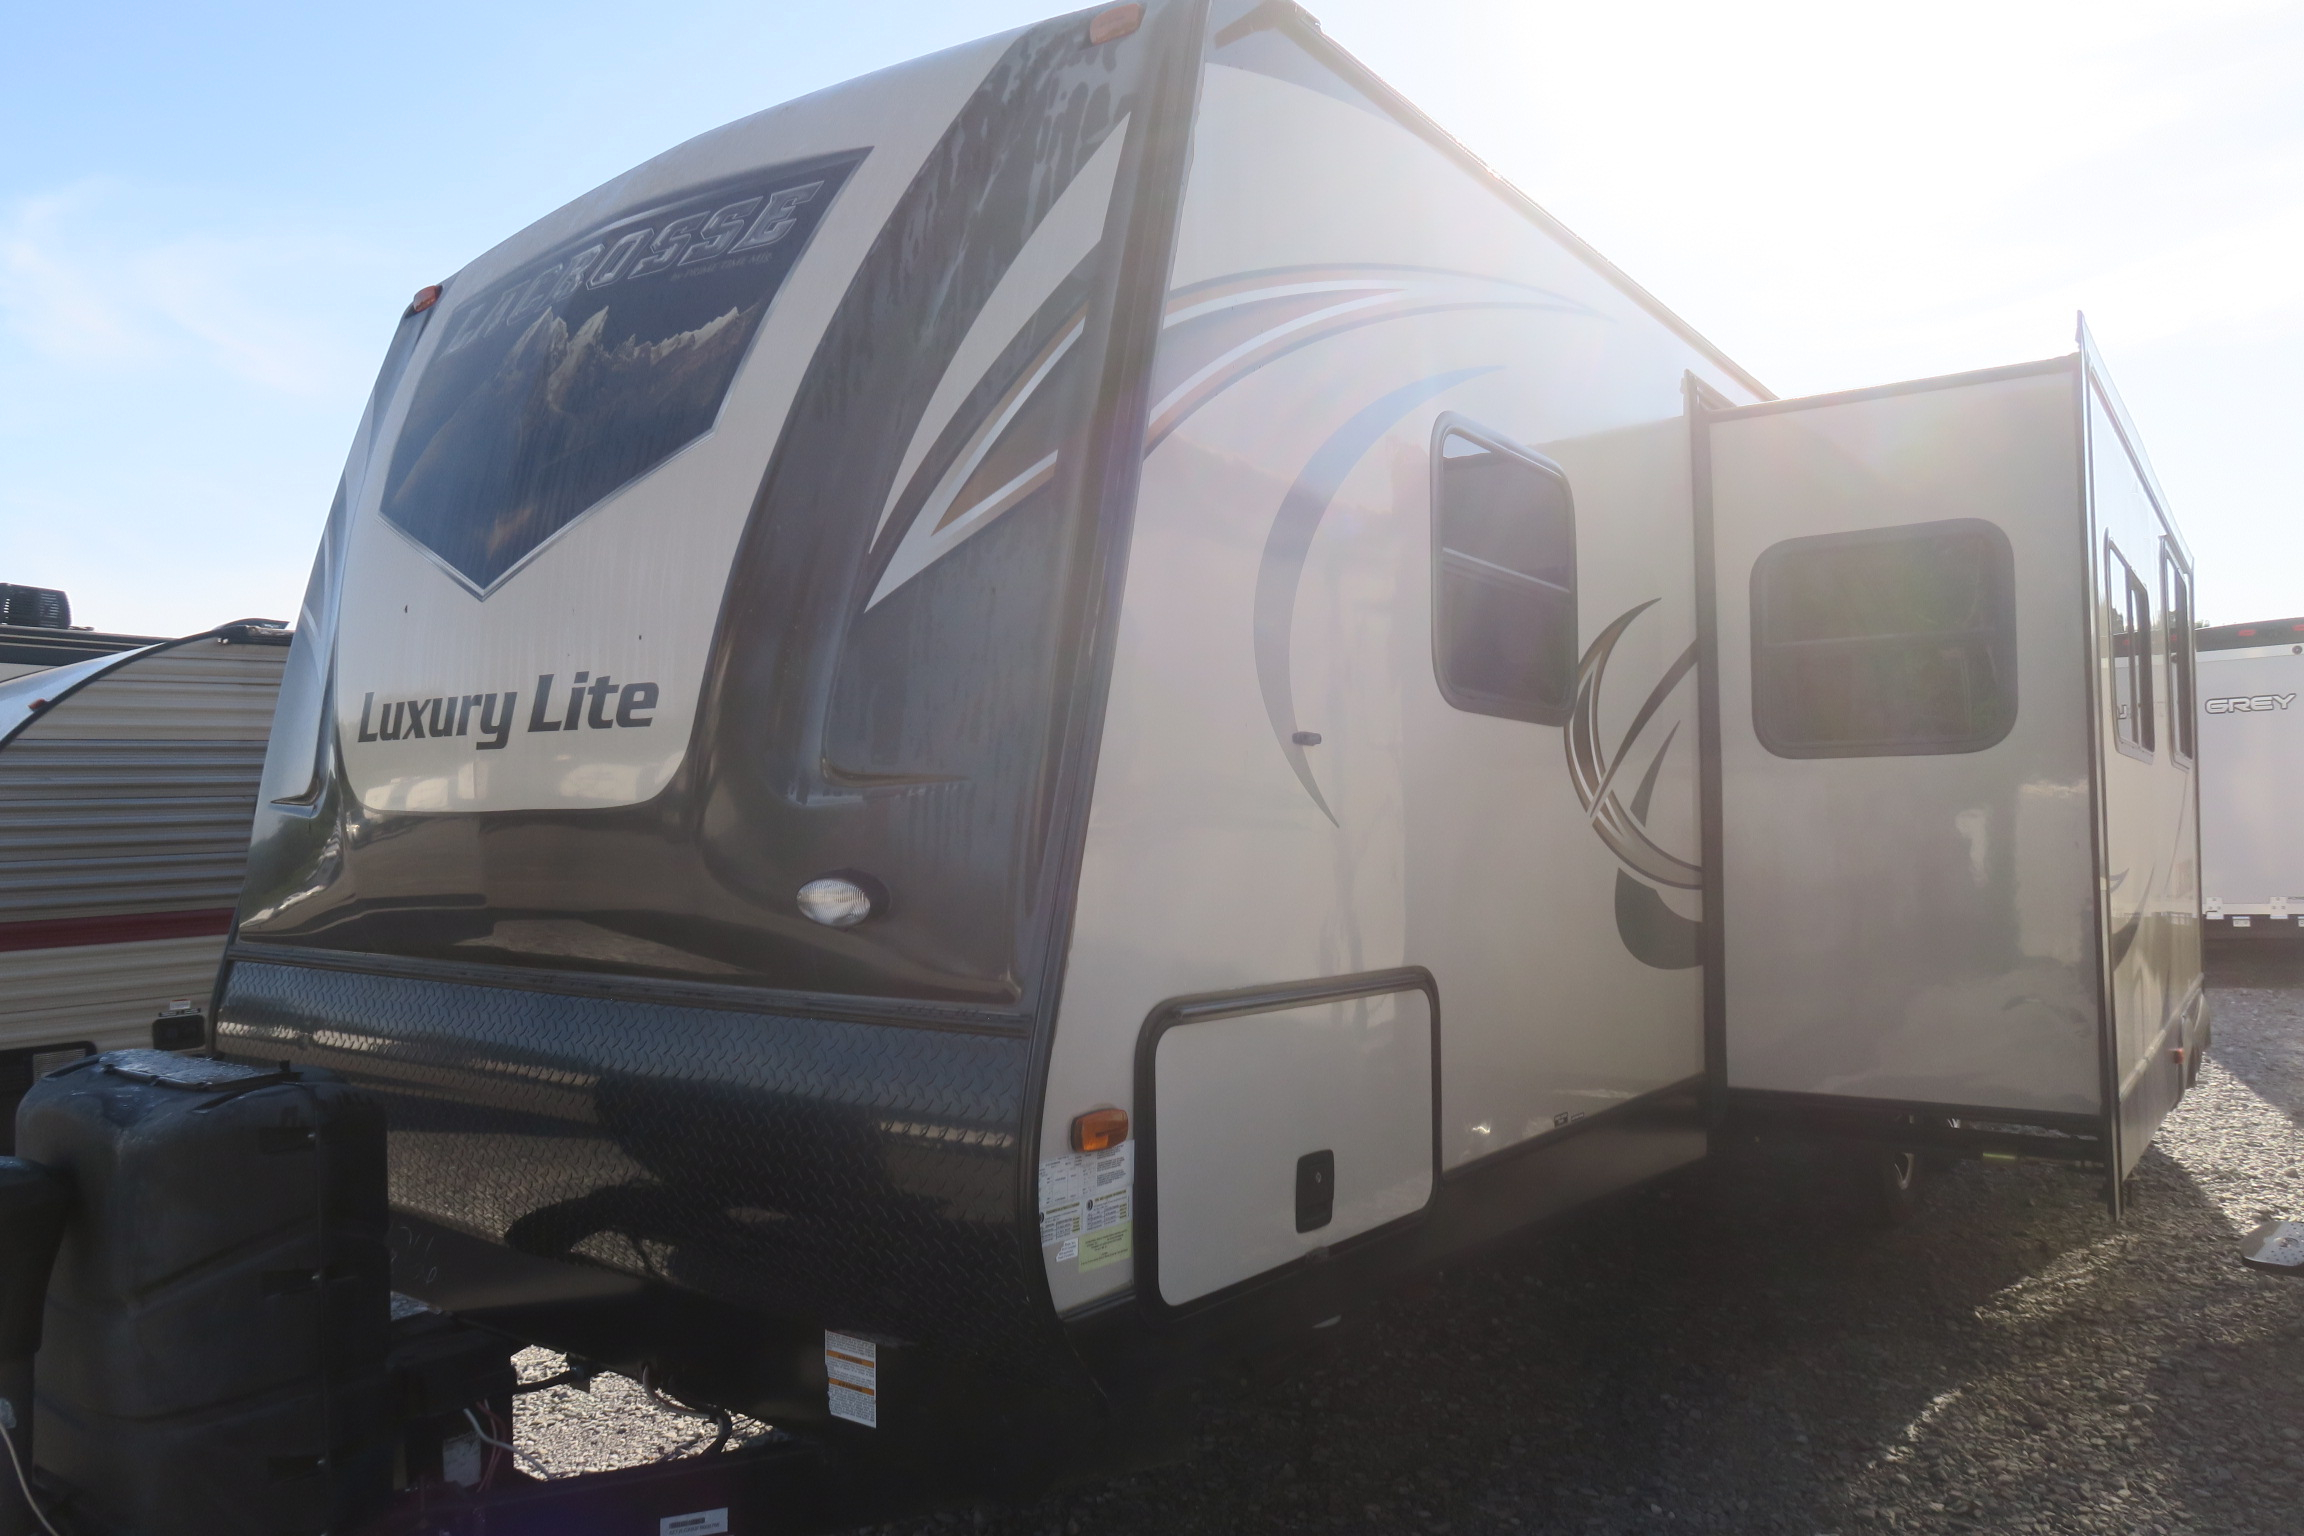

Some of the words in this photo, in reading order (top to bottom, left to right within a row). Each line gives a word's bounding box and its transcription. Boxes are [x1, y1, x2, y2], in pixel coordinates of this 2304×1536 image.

[357, 691, 518, 750] Luxury
[528, 671, 660, 733] Lite
[2205, 693, 2297, 715] GREY
